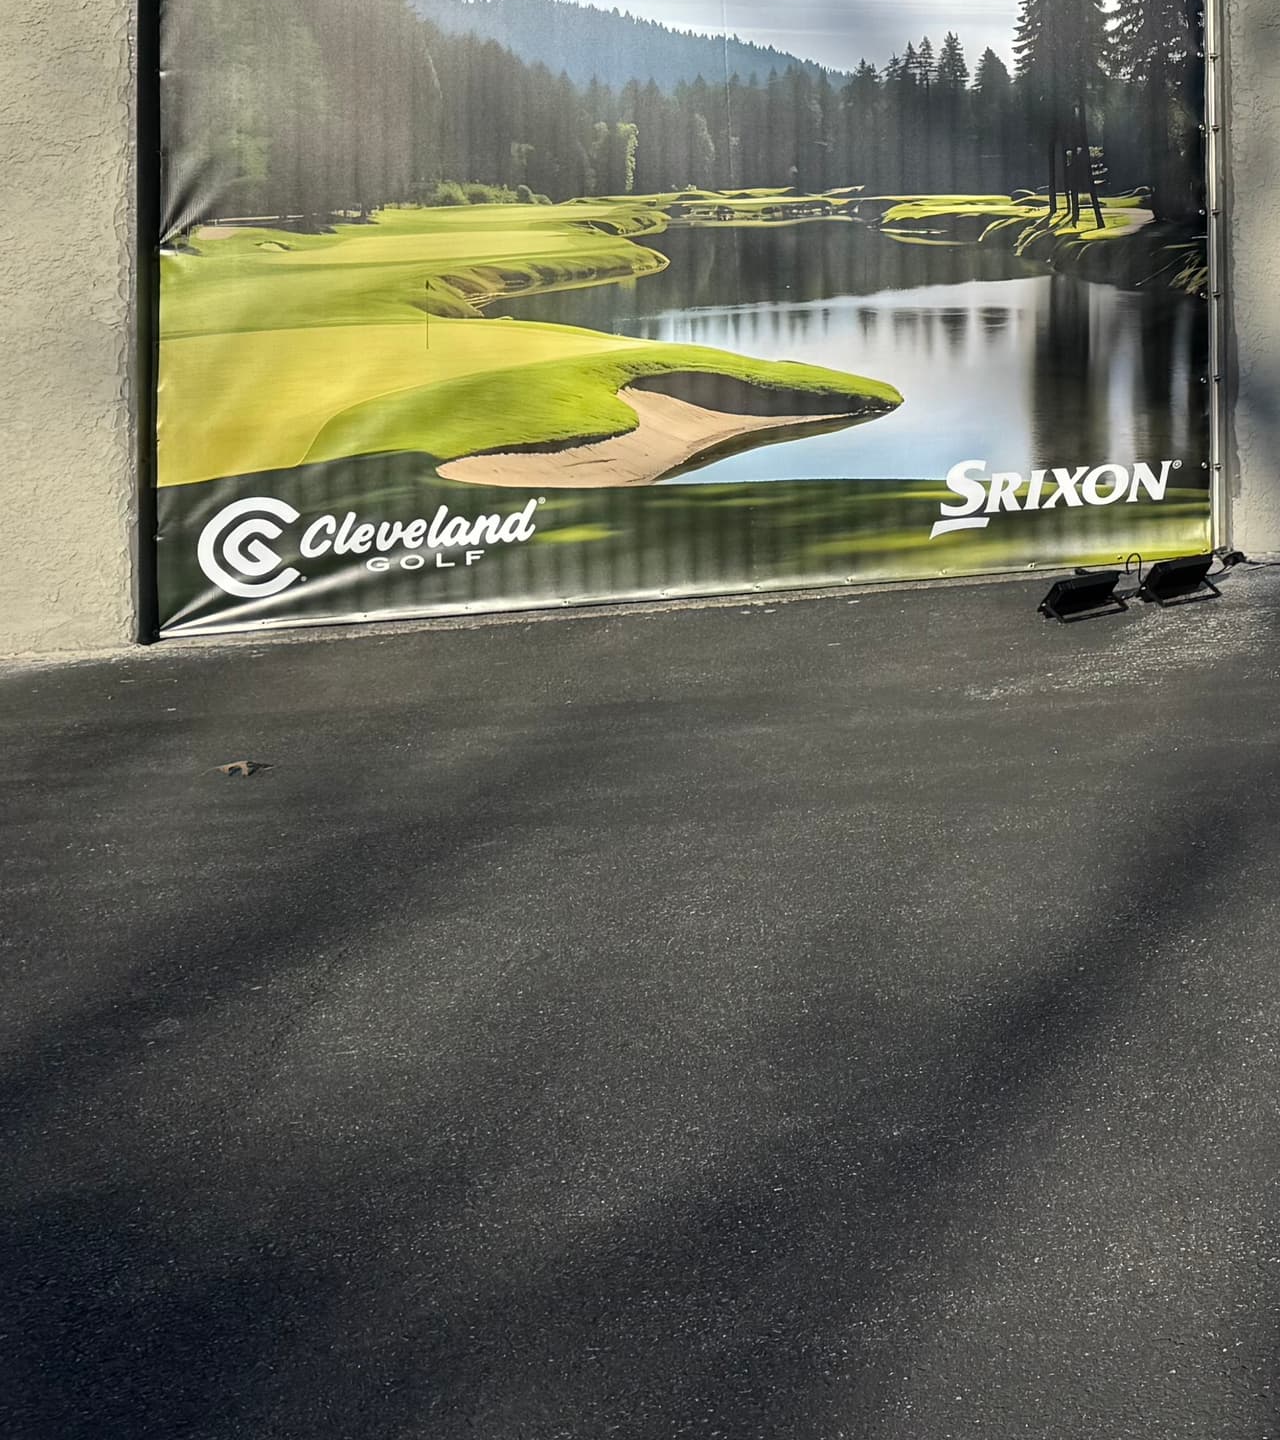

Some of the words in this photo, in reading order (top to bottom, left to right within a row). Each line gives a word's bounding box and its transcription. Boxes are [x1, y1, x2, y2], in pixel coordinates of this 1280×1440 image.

[300, 498, 538, 558] Cleveland
[929, 459, 1173, 540] SRIXON
[365, 549, 486, 572] GOLF
